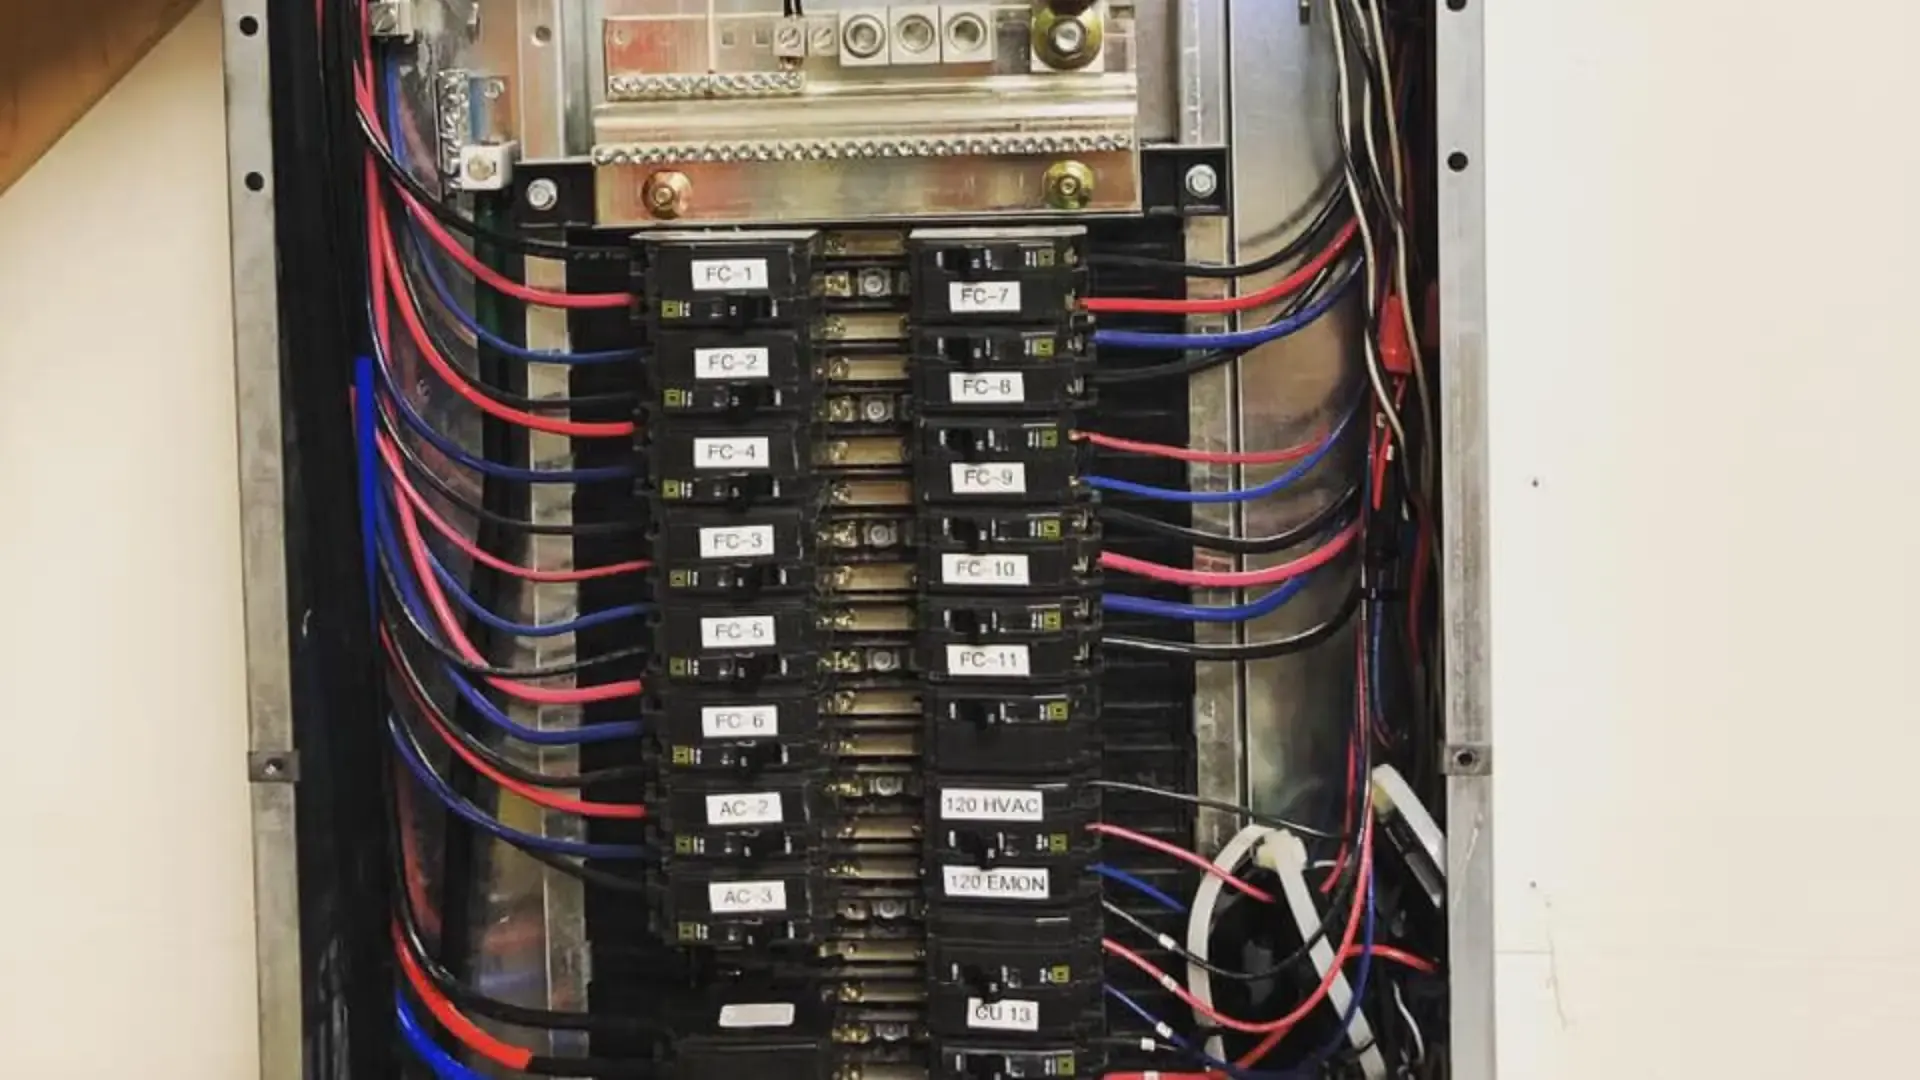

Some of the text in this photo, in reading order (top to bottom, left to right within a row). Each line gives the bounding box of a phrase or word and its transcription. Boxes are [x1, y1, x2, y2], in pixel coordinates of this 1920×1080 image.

[705, 266, 752, 283] FC-1
[961, 287, 1009, 304] FC-7
[709, 354, 757, 370] FC-2
[708, 443, 756, 460] FC-4
[964, 469, 1013, 486] FC-9
[714, 532, 763, 549] FC-3
[956, 560, 1015, 577] FC-10
[715, 622, 764, 640] FC-5
[959, 651, 1017, 668] FC-11
[716, 713, 764, 729] FC-6
[719, 799, 770, 816] AC-2
[946, 796, 1040, 814] 120 HVAC
[951, 873, 1045, 892] 120 EMON
[723, 888, 773, 905] AC-3
[975, 1005, 1031, 1023] CU 13
